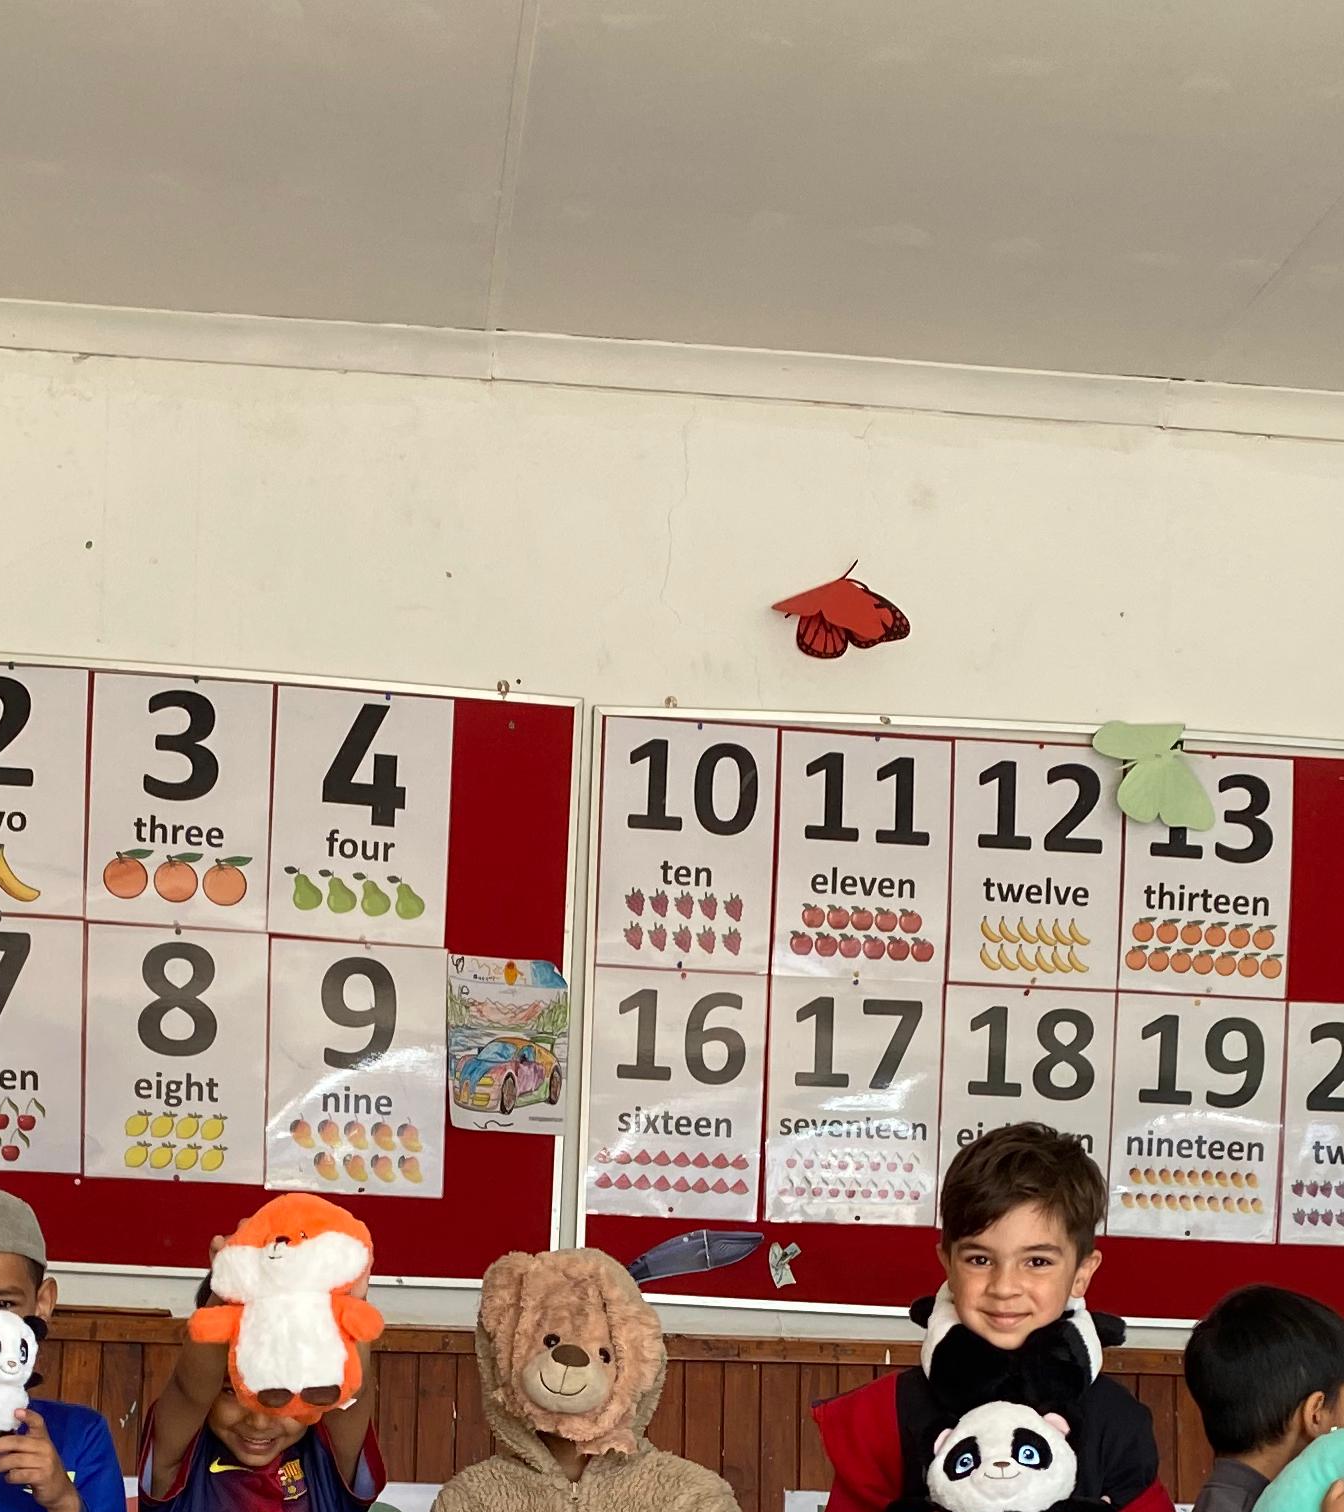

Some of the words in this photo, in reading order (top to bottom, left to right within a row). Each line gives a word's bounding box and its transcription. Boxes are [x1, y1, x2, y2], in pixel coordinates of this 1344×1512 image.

[143, 690, 219, 801] 3
[322, 704, 406, 827] 4
[628, 739, 758, 836] 10
[805, 752, 930, 846] 11
[978, 761, 1102, 854] 12
[134, 815, 224, 848] three
[326, 829, 395, 862] four
[660, 861, 711, 887] ten
[811, 867, 915, 898] eleven
[983, 877, 1089, 906] twelve
[1144, 883, 1269, 916] thirteen
[138, 942, 217, 1056] 8
[321, 957, 396, 1070] 9
[617, 989, 746, 1085] 16
[795, 997, 923, 1089] 17
[968, 1006, 1094, 1101] 18
[1139, 1015, 1264, 1108] 19
[134, 1073, 218, 1107] eight
[322, 1086, 392, 1116] nine
[618, 1106, 731, 1138] sixteen
[780, 1117, 927, 1141] seventeen
[1127, 1131, 1264, 1161] nineteen
